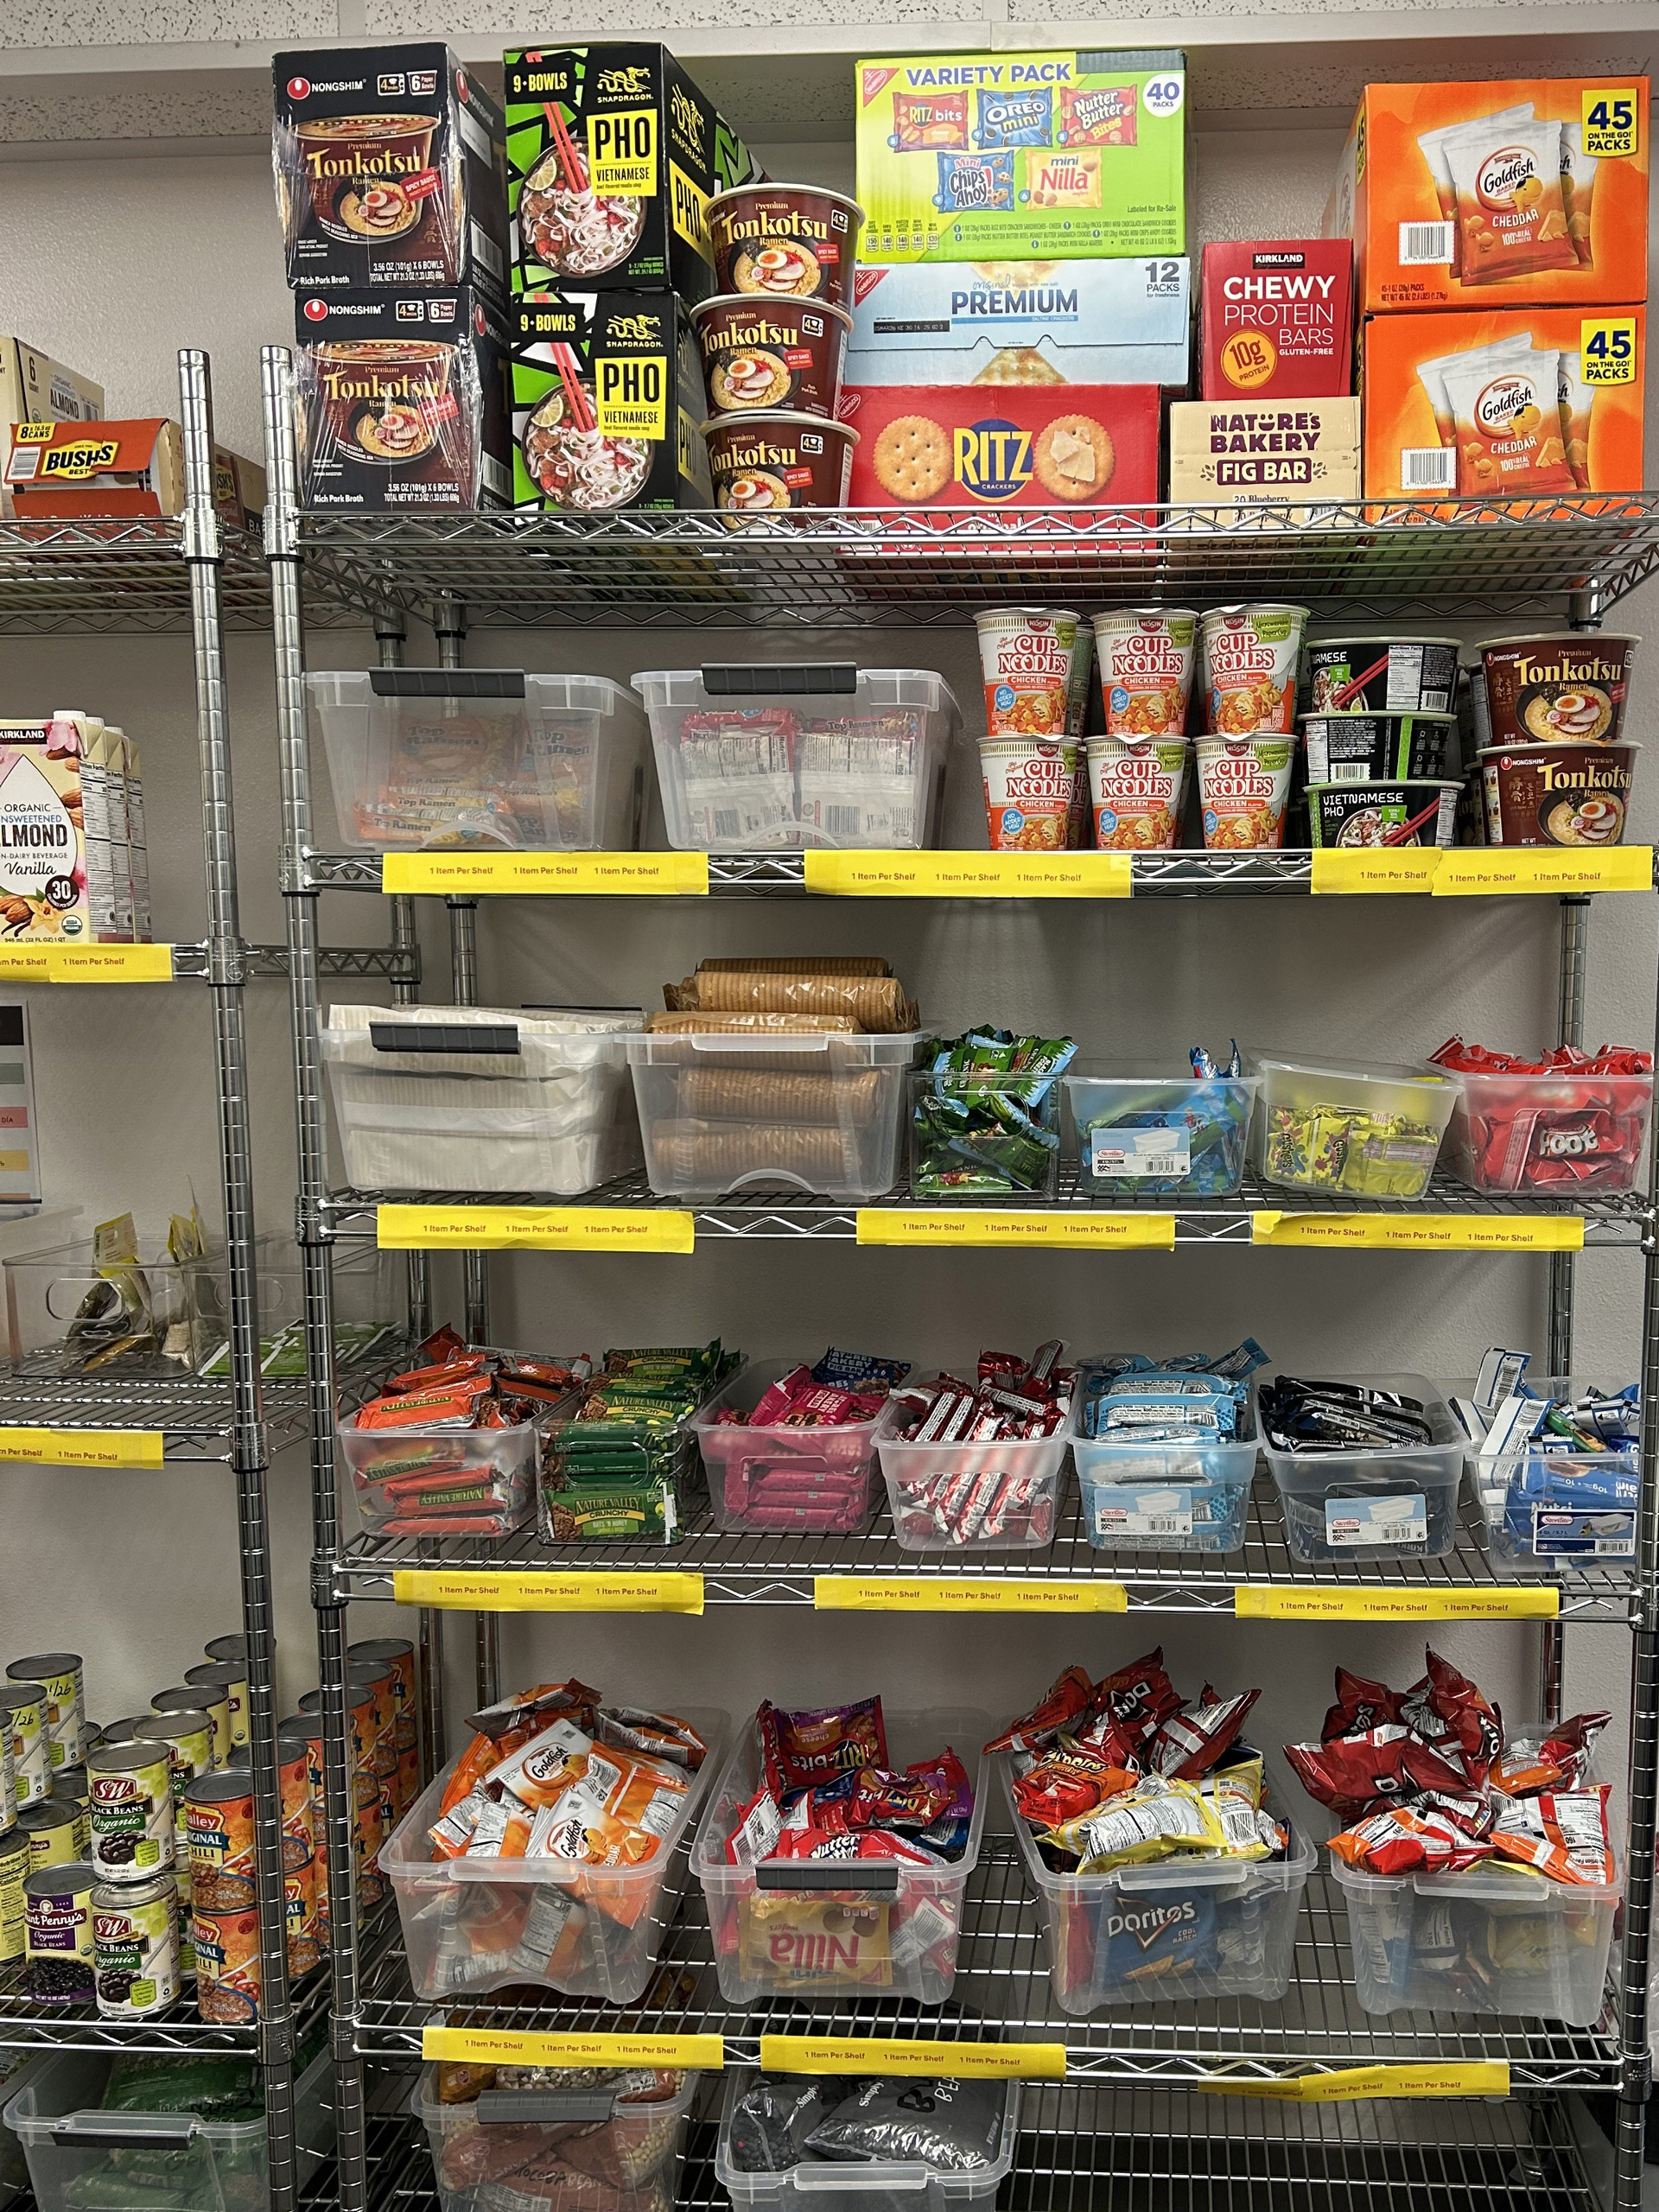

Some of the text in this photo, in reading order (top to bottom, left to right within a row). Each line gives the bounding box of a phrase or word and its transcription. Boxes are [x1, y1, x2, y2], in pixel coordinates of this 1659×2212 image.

[528, 72, 568, 92] BOWLS
[906, 63, 1071, 86] VARIETY PACK
[311, 80, 364, 92] NONGSHIM
[1147, 82, 1179, 100] 40
[597, 94, 653, 103] SNAPDRAGON
[1074, 92, 1118, 118] Nutter
[910, 106, 963, 123] RITZ bits
[987, 102, 1045, 122] OREO
[1081, 102, 1123, 130] Butter
[1588, 101, 1632, 130] 45
[1002, 114, 1039, 133] mini
[1090, 118, 1122, 140] Bites
[594, 117, 652, 161] PHO
[1588, 140, 1630, 151] PACKS
[307, 149, 421, 179] Tonkotsu
[954, 157, 981, 169] Mini
[1051, 156, 1078, 167] mini
[596, 167, 650, 181] VIETNAMESE
[950, 169, 985, 194] Chips
[1040, 167, 1089, 191] Nilla
[1484, 159, 1535, 194] Goldfish
[676, 175, 702, 244] PHO
[755, 200, 789, 210] Premium
[721, 210, 828, 245] Tonkotsu
[1492, 209, 1540, 228] CHEDDAR
[760, 238, 789, 246] Ramen
[1255, 254, 1304, 264] KIRKLAND
[1146, 261, 1179, 283] 12
[857, 273, 877, 294] NABISCO
[1147, 283, 1180, 293] PACKS
[1224, 276, 1336, 300] CHEWY
[329, 305, 382, 315] NONGSHIM
[951, 289, 1078, 315] PREMIUM
[536, 315, 576, 332] BOWLS
[1224, 303, 1333, 326] PROTEIN
[701, 319, 798, 353] Tonkotsu
[1279, 328, 1333, 346] BARS
[1586, 330, 1630, 359] 45
[1230, 340, 1266, 370] 10g
[29, 356, 36, 382] 6
[1238, 364, 1269, 382] PROTEIN
[1586, 369, 1629, 379] PACKS
[323, 368, 439, 400] Tonkotsu
[603, 363, 660, 403] PHO
[50, 388, 79, 420] ALMOND
[1482, 389, 1532, 422] Goldfish
[604, 410, 658, 423] VIETNAMESE
[21, 426, 29, 439] 8
[1211, 432, 1320, 453] BAKERY
[1491, 435, 1538, 454] CHEDDAR
[46, 445, 113, 471] BUSHS
[954, 428, 1033, 485] RITZ
[1221, 461, 1307, 482] FIG BAR
[1015, 635, 1060, 654] CUP
[1128, 635, 1173, 655] CUP
[999, 653, 1068, 675] NOODLES
[1113, 654, 1184, 676] NOODLES
[1514, 655, 1622, 686] Tonkotsu
[1011, 676, 1046, 684] CHICKEN
[1559, 683, 1589, 691] Ramen
[1025, 760, 1065, 779] CUP
[1116, 760, 1159, 779] CUP
[1537, 760, 1632, 791] Tonkotsu
[1007, 778, 1071, 798] NOODLES
[1102, 778, 1172, 798] NOODLES
[4, 804, 51, 812] ORGANIC
[397, 797, 456, 808] Top Ramen
[1323, 792, 1404, 805] VIETNAMESE
[1324, 803, 1344, 817] PHO
[0, 823, 68, 848] LMOND
[4, 861, 56, 875] Vanilla
[943, 873, 961, 881] Item
[963, 873, 976, 881] Per
[978, 873, 1000, 881] Shelf
[52, 881, 72, 899] 30
[69, 957, 87, 966] Item
[89, 957, 102, 966] Per
[612, 1225, 625, 1234] Per
[626, 1225, 648, 1234] Shelf
[991, 1224, 1009, 1232] Item
[1027, 1224, 1047, 1233] Shelf
[1392, 1230, 1411, 1239] Item
[1414, 1231, 1427, 1240] Per
[1428, 1231, 1451, 1240] Shelf
[575, 1497, 640, 1515] NATURE VALLEY
[589, 1510, 629, 1519] CRUNCHY
[1545, 1516, 1572, 1524] Sterilite
[1044, 1592, 1056, 1601] Per
[1058, 1592, 1078, 1601] Shelf
[532, 1745, 569, 1777] Goldfish
[791, 1744, 868, 1770] RITZ bits
[96, 1780, 129, 1800] S&W
[114, 1804, 144, 1815] BEANS
[93, 1815, 141, 1833] Organic
[41, 1913, 84, 1925] Penny's
[1108, 1900, 1196, 1937] Doritos
[1173, 1932, 1198, 1943] RANCH
[1178, 1928, 1197, 1936] COOL
[769, 1934, 860, 1971] Nilla
[623, 2045, 640, 2054] Item
[642, 2045, 655, 2054] Per
[657, 2046, 677, 2055] Shelf
